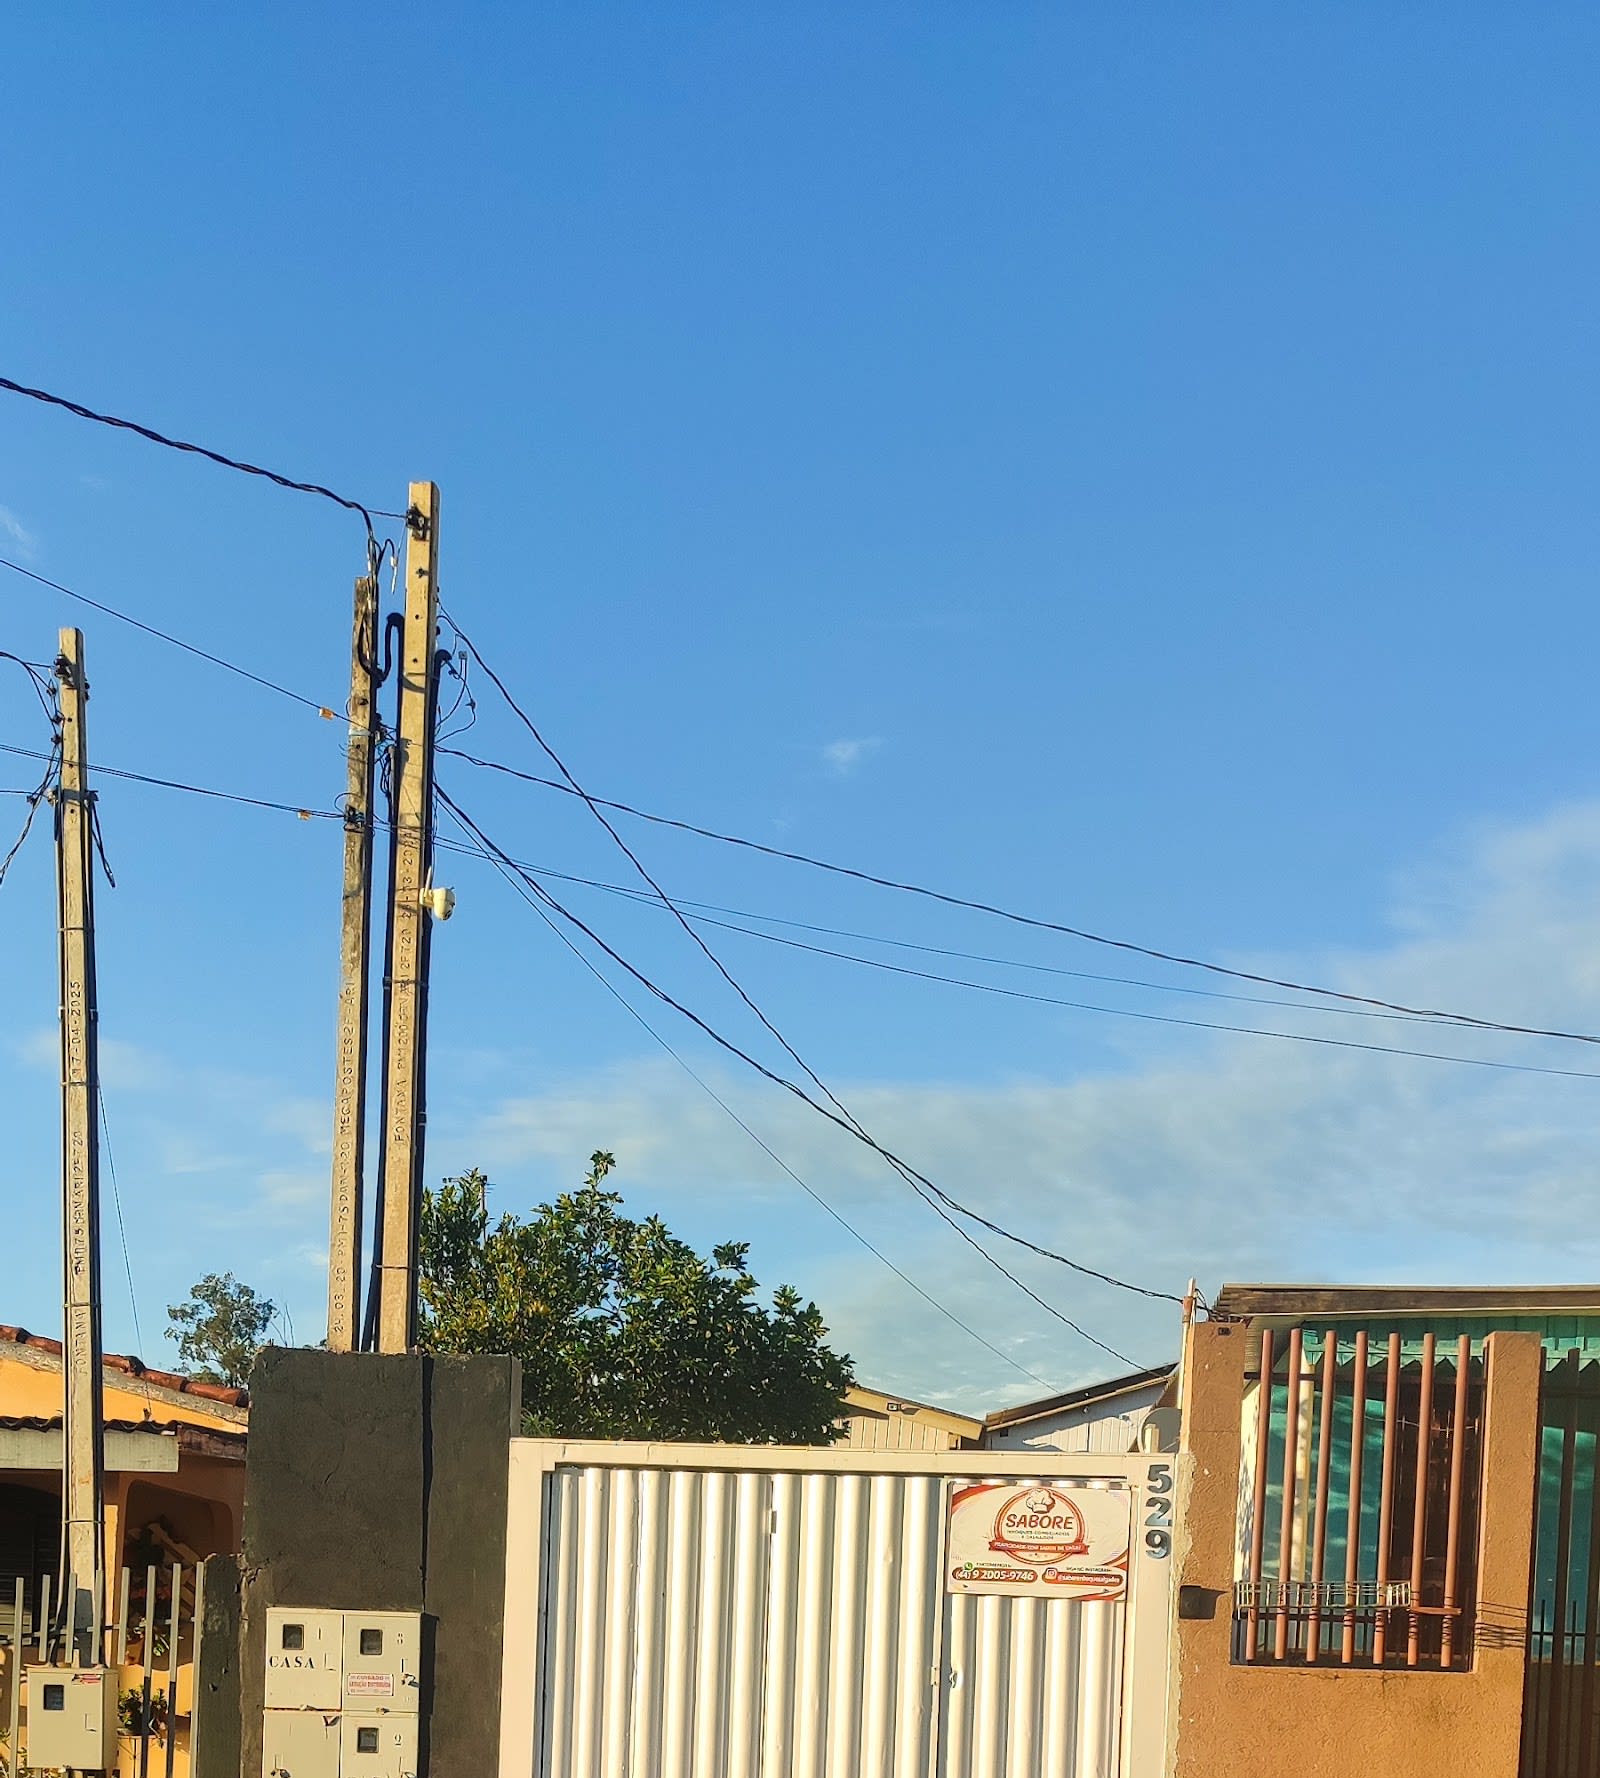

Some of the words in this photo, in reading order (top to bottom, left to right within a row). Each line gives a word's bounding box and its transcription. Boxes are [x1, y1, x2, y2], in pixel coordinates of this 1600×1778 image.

[1005, 1513, 1074, 1530] SABORE
[981, 1570, 1034, 1581] 2005-9746
[269, 1655, 315, 1669] CASA
